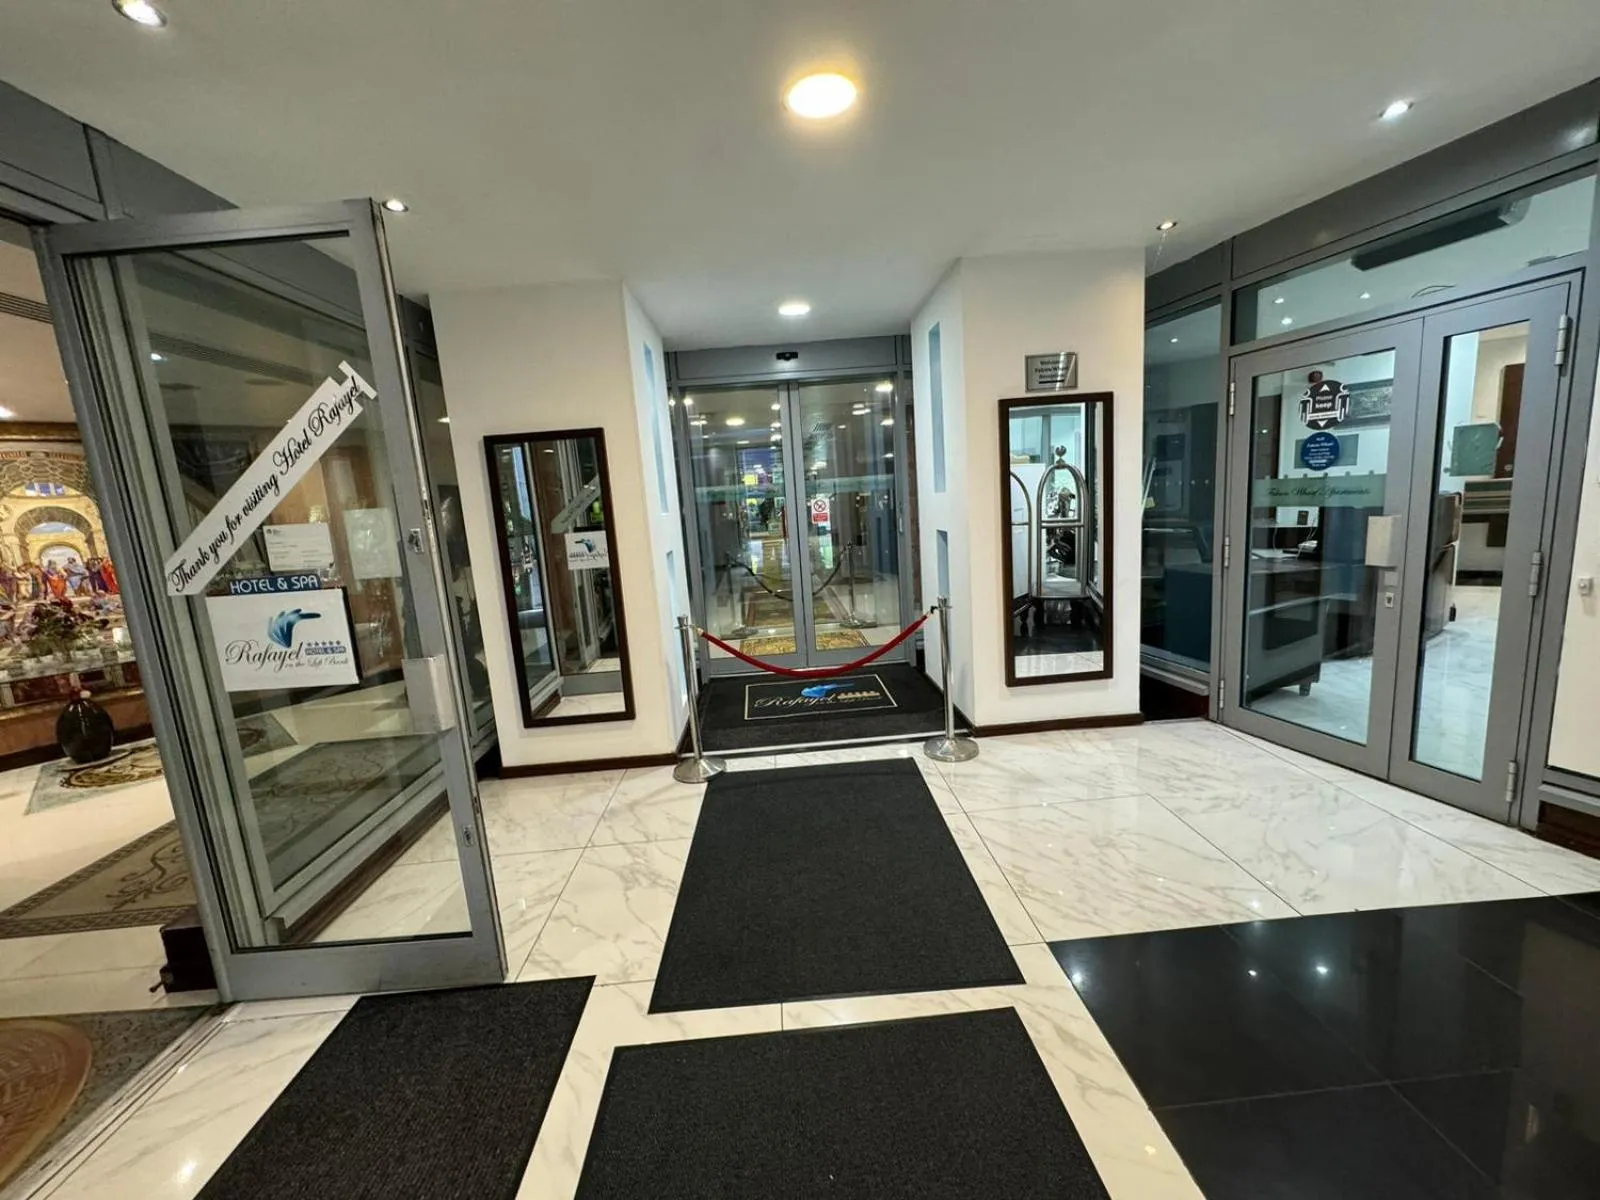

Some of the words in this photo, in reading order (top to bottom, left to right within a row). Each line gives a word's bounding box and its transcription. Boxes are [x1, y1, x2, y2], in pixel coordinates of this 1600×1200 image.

[170, 547, 209, 592] Thank
[208, 533, 227, 564] you
[225, 511, 243, 545] for
[242, 473, 279, 519] visiting
[272, 428, 312, 475] Hotel
[308, 375, 361, 437] Rafayel
[229, 578, 274, 593] HOTEL
[277, 578, 288, 591] &
[292, 575, 319, 589] SPA
[225, 639, 303, 673] Rafayel
[753, 693, 836, 709] Rafayel
